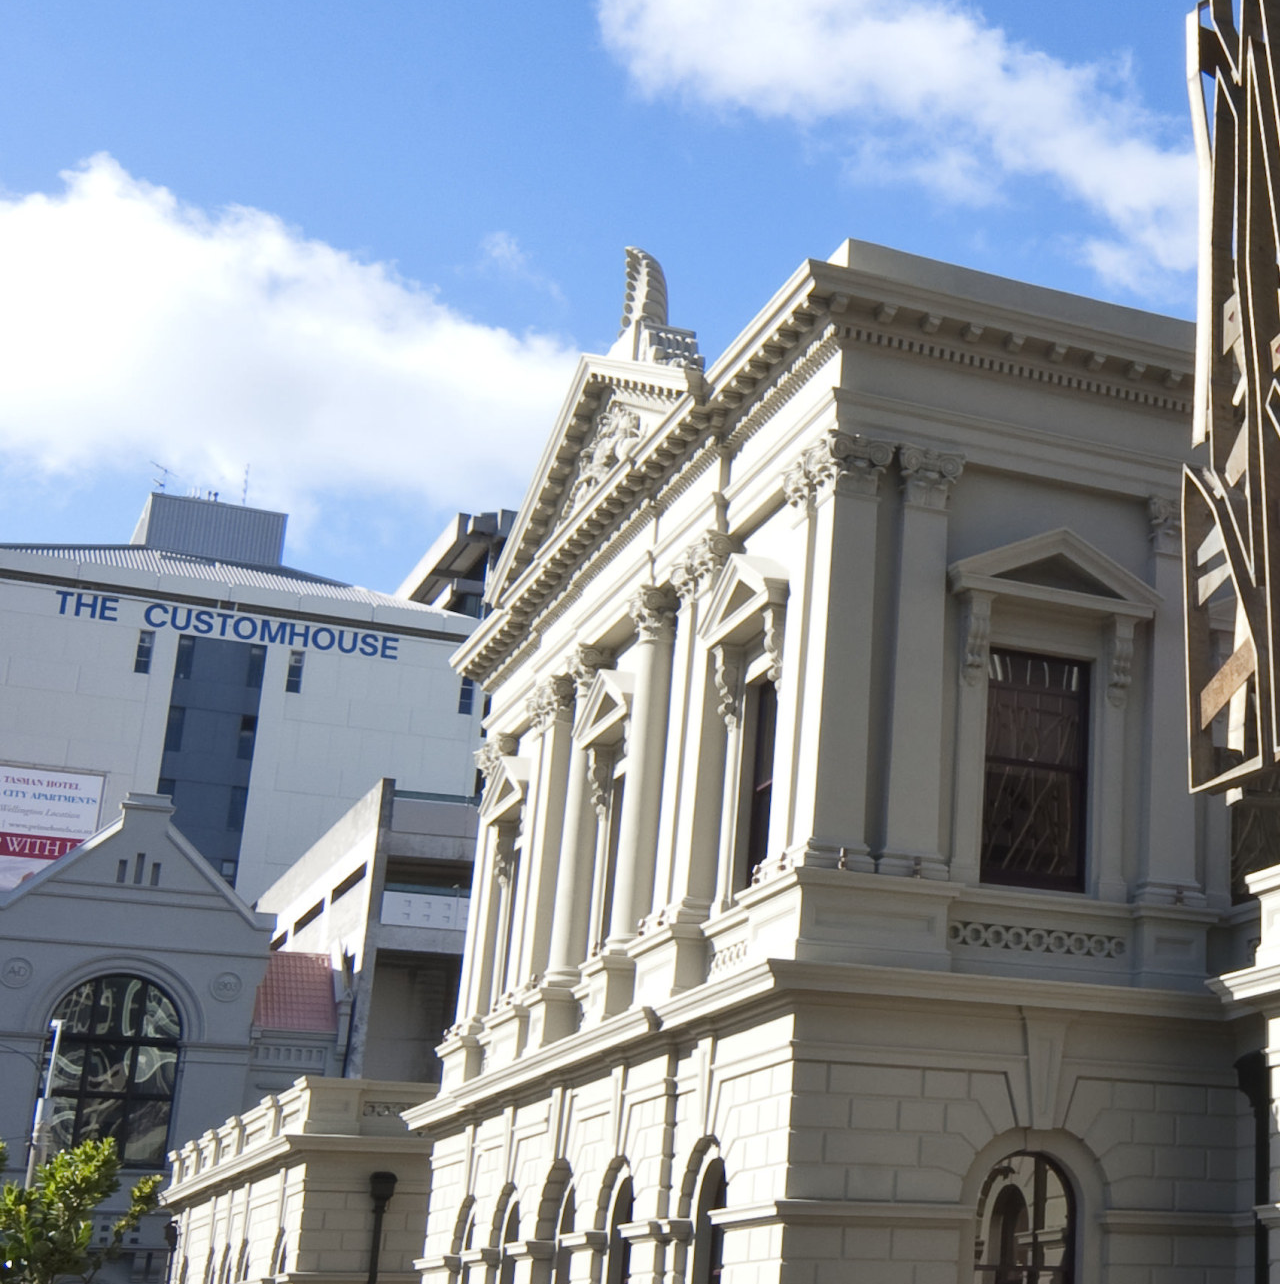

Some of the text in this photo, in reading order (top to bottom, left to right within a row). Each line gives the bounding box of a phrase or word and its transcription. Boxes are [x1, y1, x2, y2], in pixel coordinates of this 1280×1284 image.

[55, 590, 400, 661] THE CUSTOMHOUSE
[4, 776, 81, 791] TASMAN HOTEL
[3, 789, 97, 805] CITY APARTMENTS
[44, 808, 80, 819] Location
[6, 836, 60, 856] WITH
